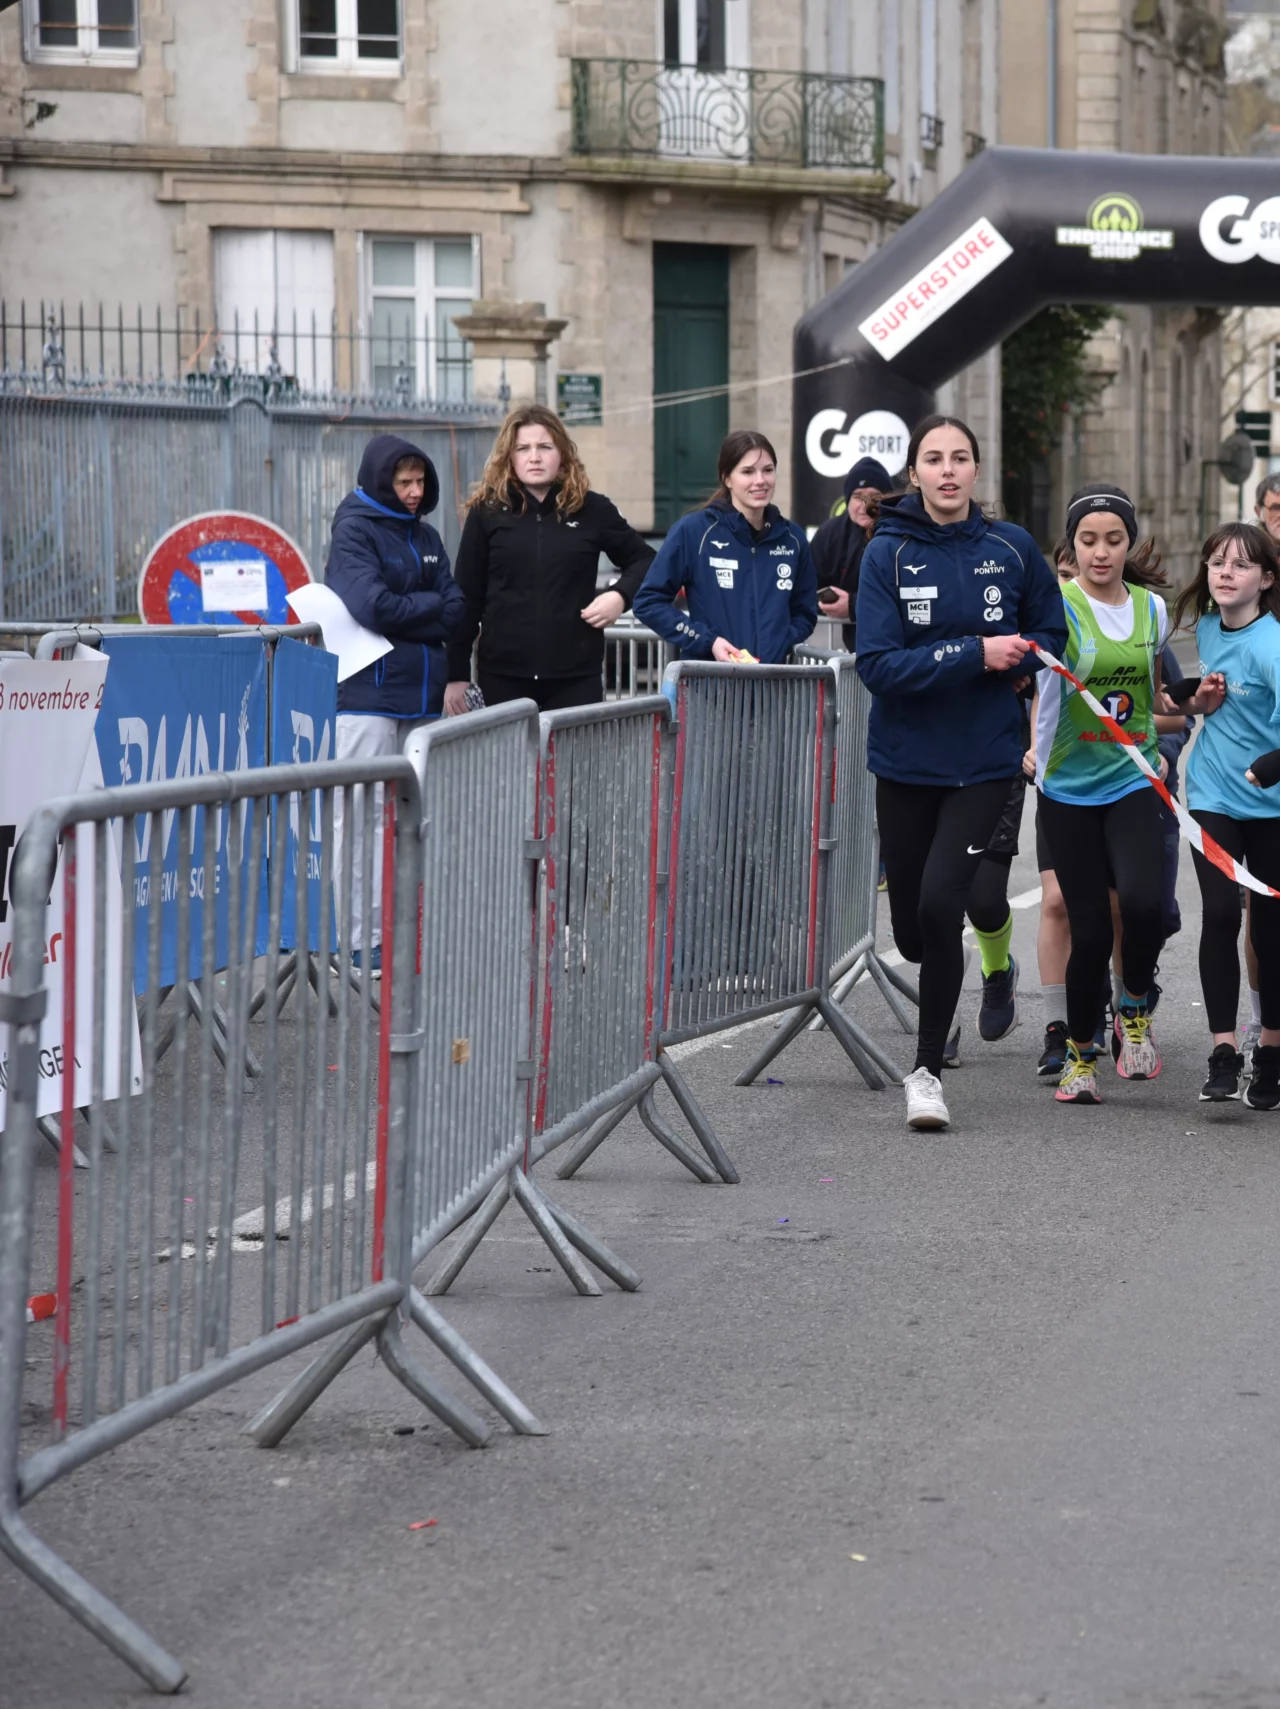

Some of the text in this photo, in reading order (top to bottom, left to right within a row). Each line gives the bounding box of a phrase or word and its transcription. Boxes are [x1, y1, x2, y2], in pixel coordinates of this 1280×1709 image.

[871, 229, 995, 341] SUPERSTORE
[858, 434, 902, 454] SPORT
[974, 567, 1005, 575] PONTIVY
[909, 603, 929, 611] MCE
[1112, 666, 1137, 676] AP
[1085, 673, 1149, 687] PONTIVY
[9, 679, 90, 710] novembre
